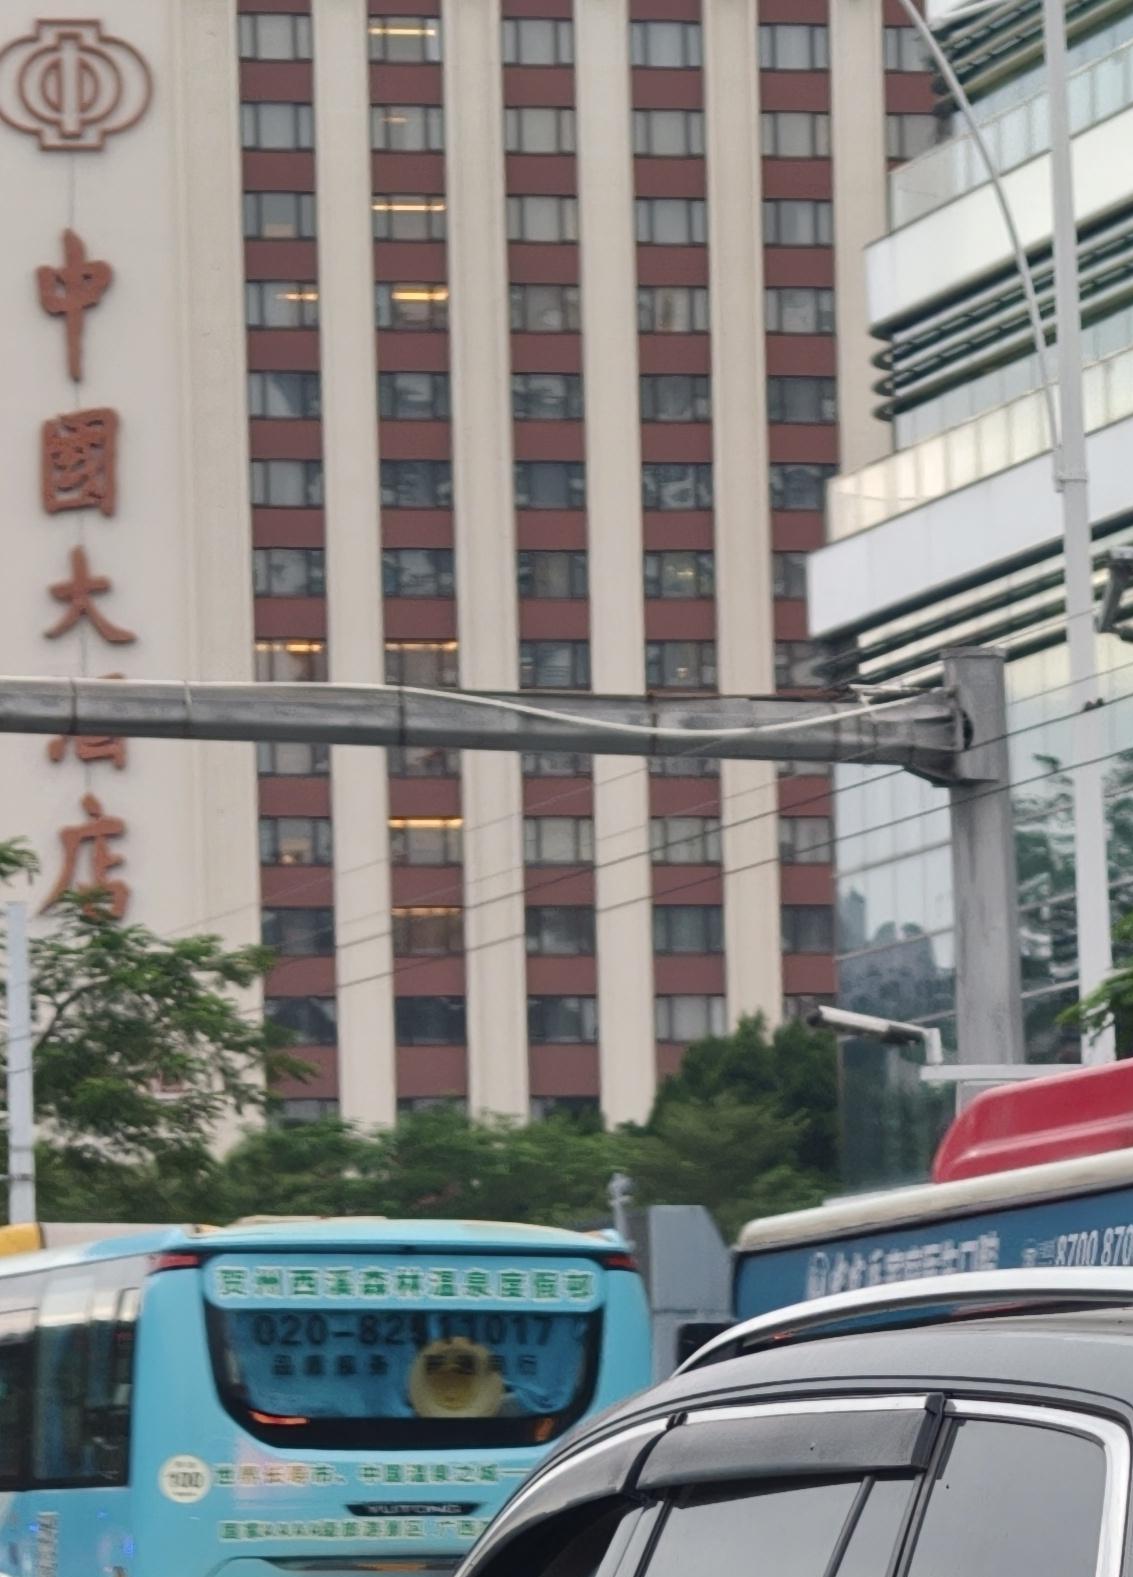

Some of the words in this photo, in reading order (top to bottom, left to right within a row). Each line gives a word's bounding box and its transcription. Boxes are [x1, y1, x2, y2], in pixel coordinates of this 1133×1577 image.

[36, 228, 137, 922] 中國大店
[1055, 1231, 1098, 1266] 8700
